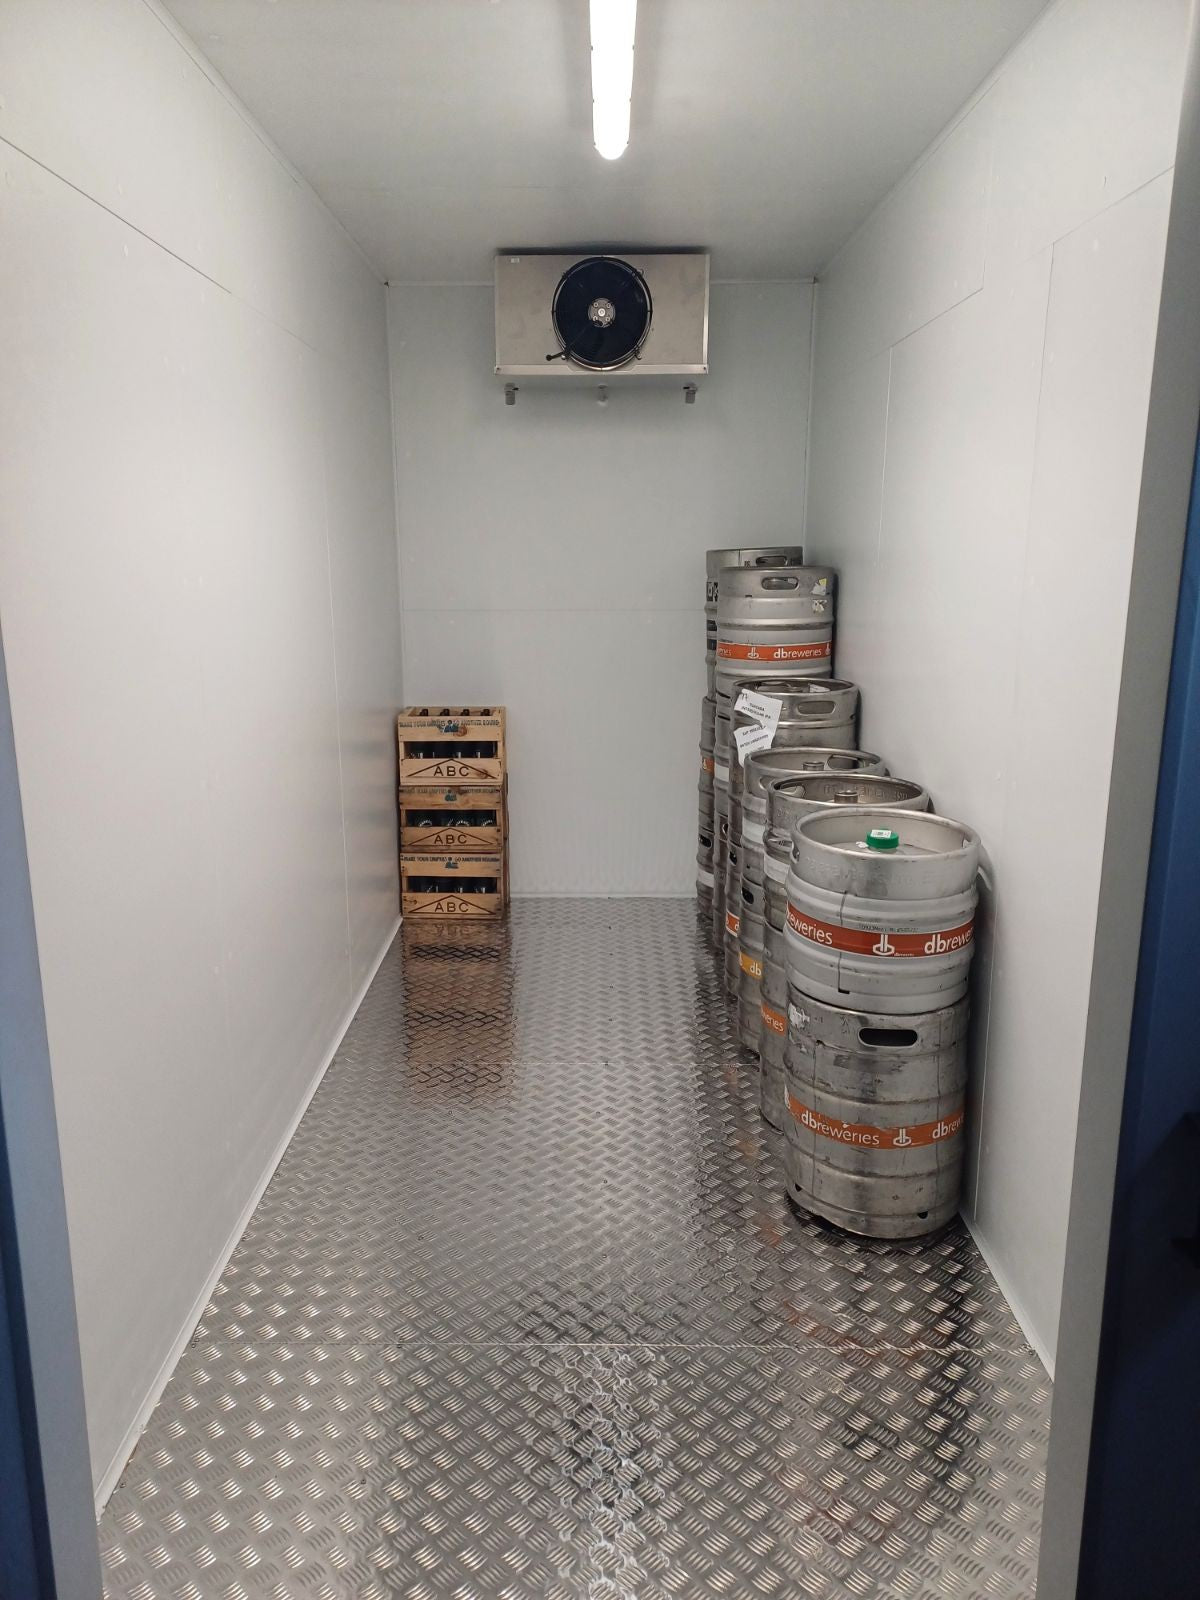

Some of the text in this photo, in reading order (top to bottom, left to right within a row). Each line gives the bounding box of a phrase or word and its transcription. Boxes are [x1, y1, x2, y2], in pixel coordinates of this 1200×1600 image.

[773, 647, 822, 659] dbreweries
[433, 765, 470, 777] ABC
[434, 834, 468, 845] ABC
[434, 901, 469, 913] ABC
[801, 1110, 880, 1145] dbreweries
